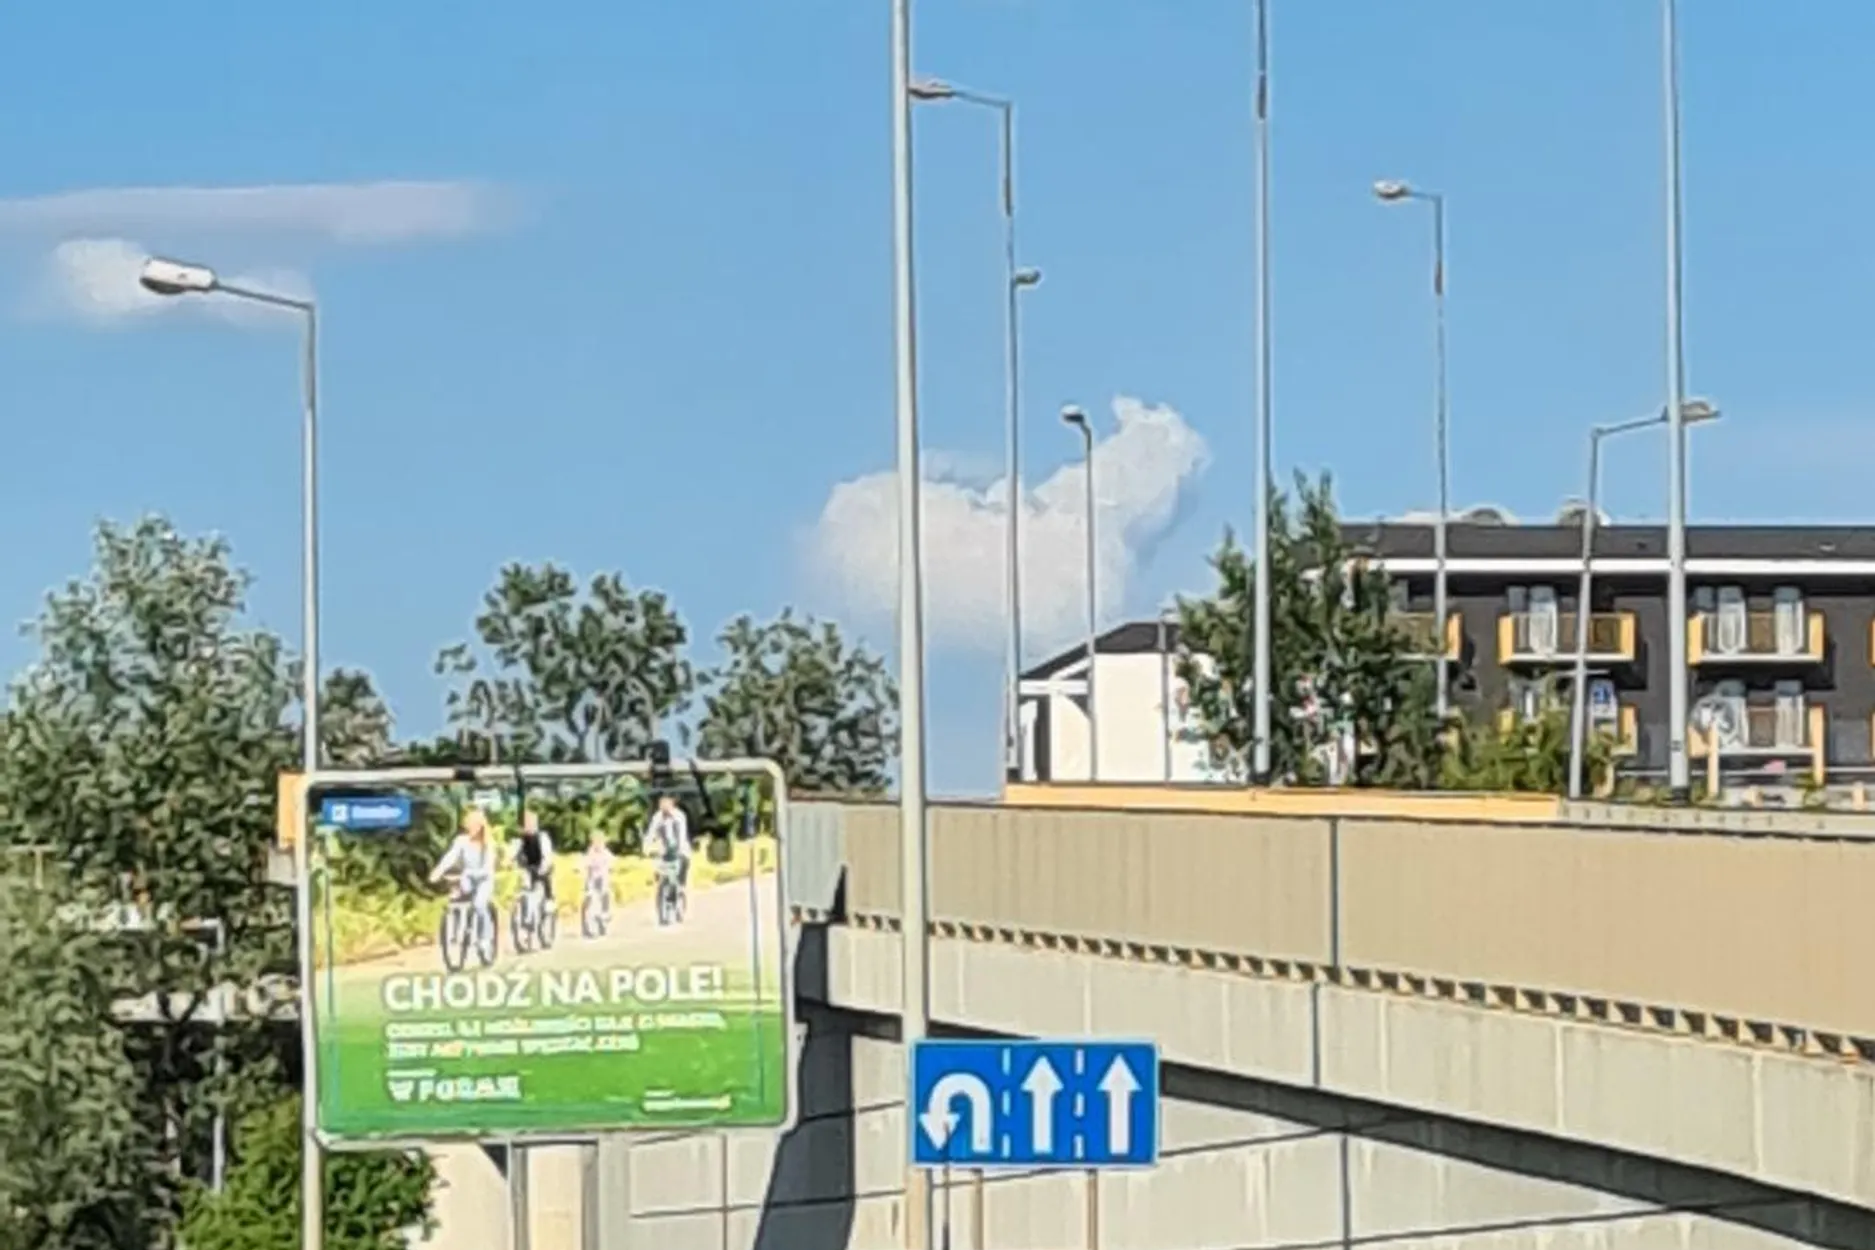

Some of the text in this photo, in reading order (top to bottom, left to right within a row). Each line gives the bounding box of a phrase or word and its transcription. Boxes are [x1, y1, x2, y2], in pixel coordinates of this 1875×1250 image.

[384, 965, 722, 1010] CHODŹ NA POLE!
